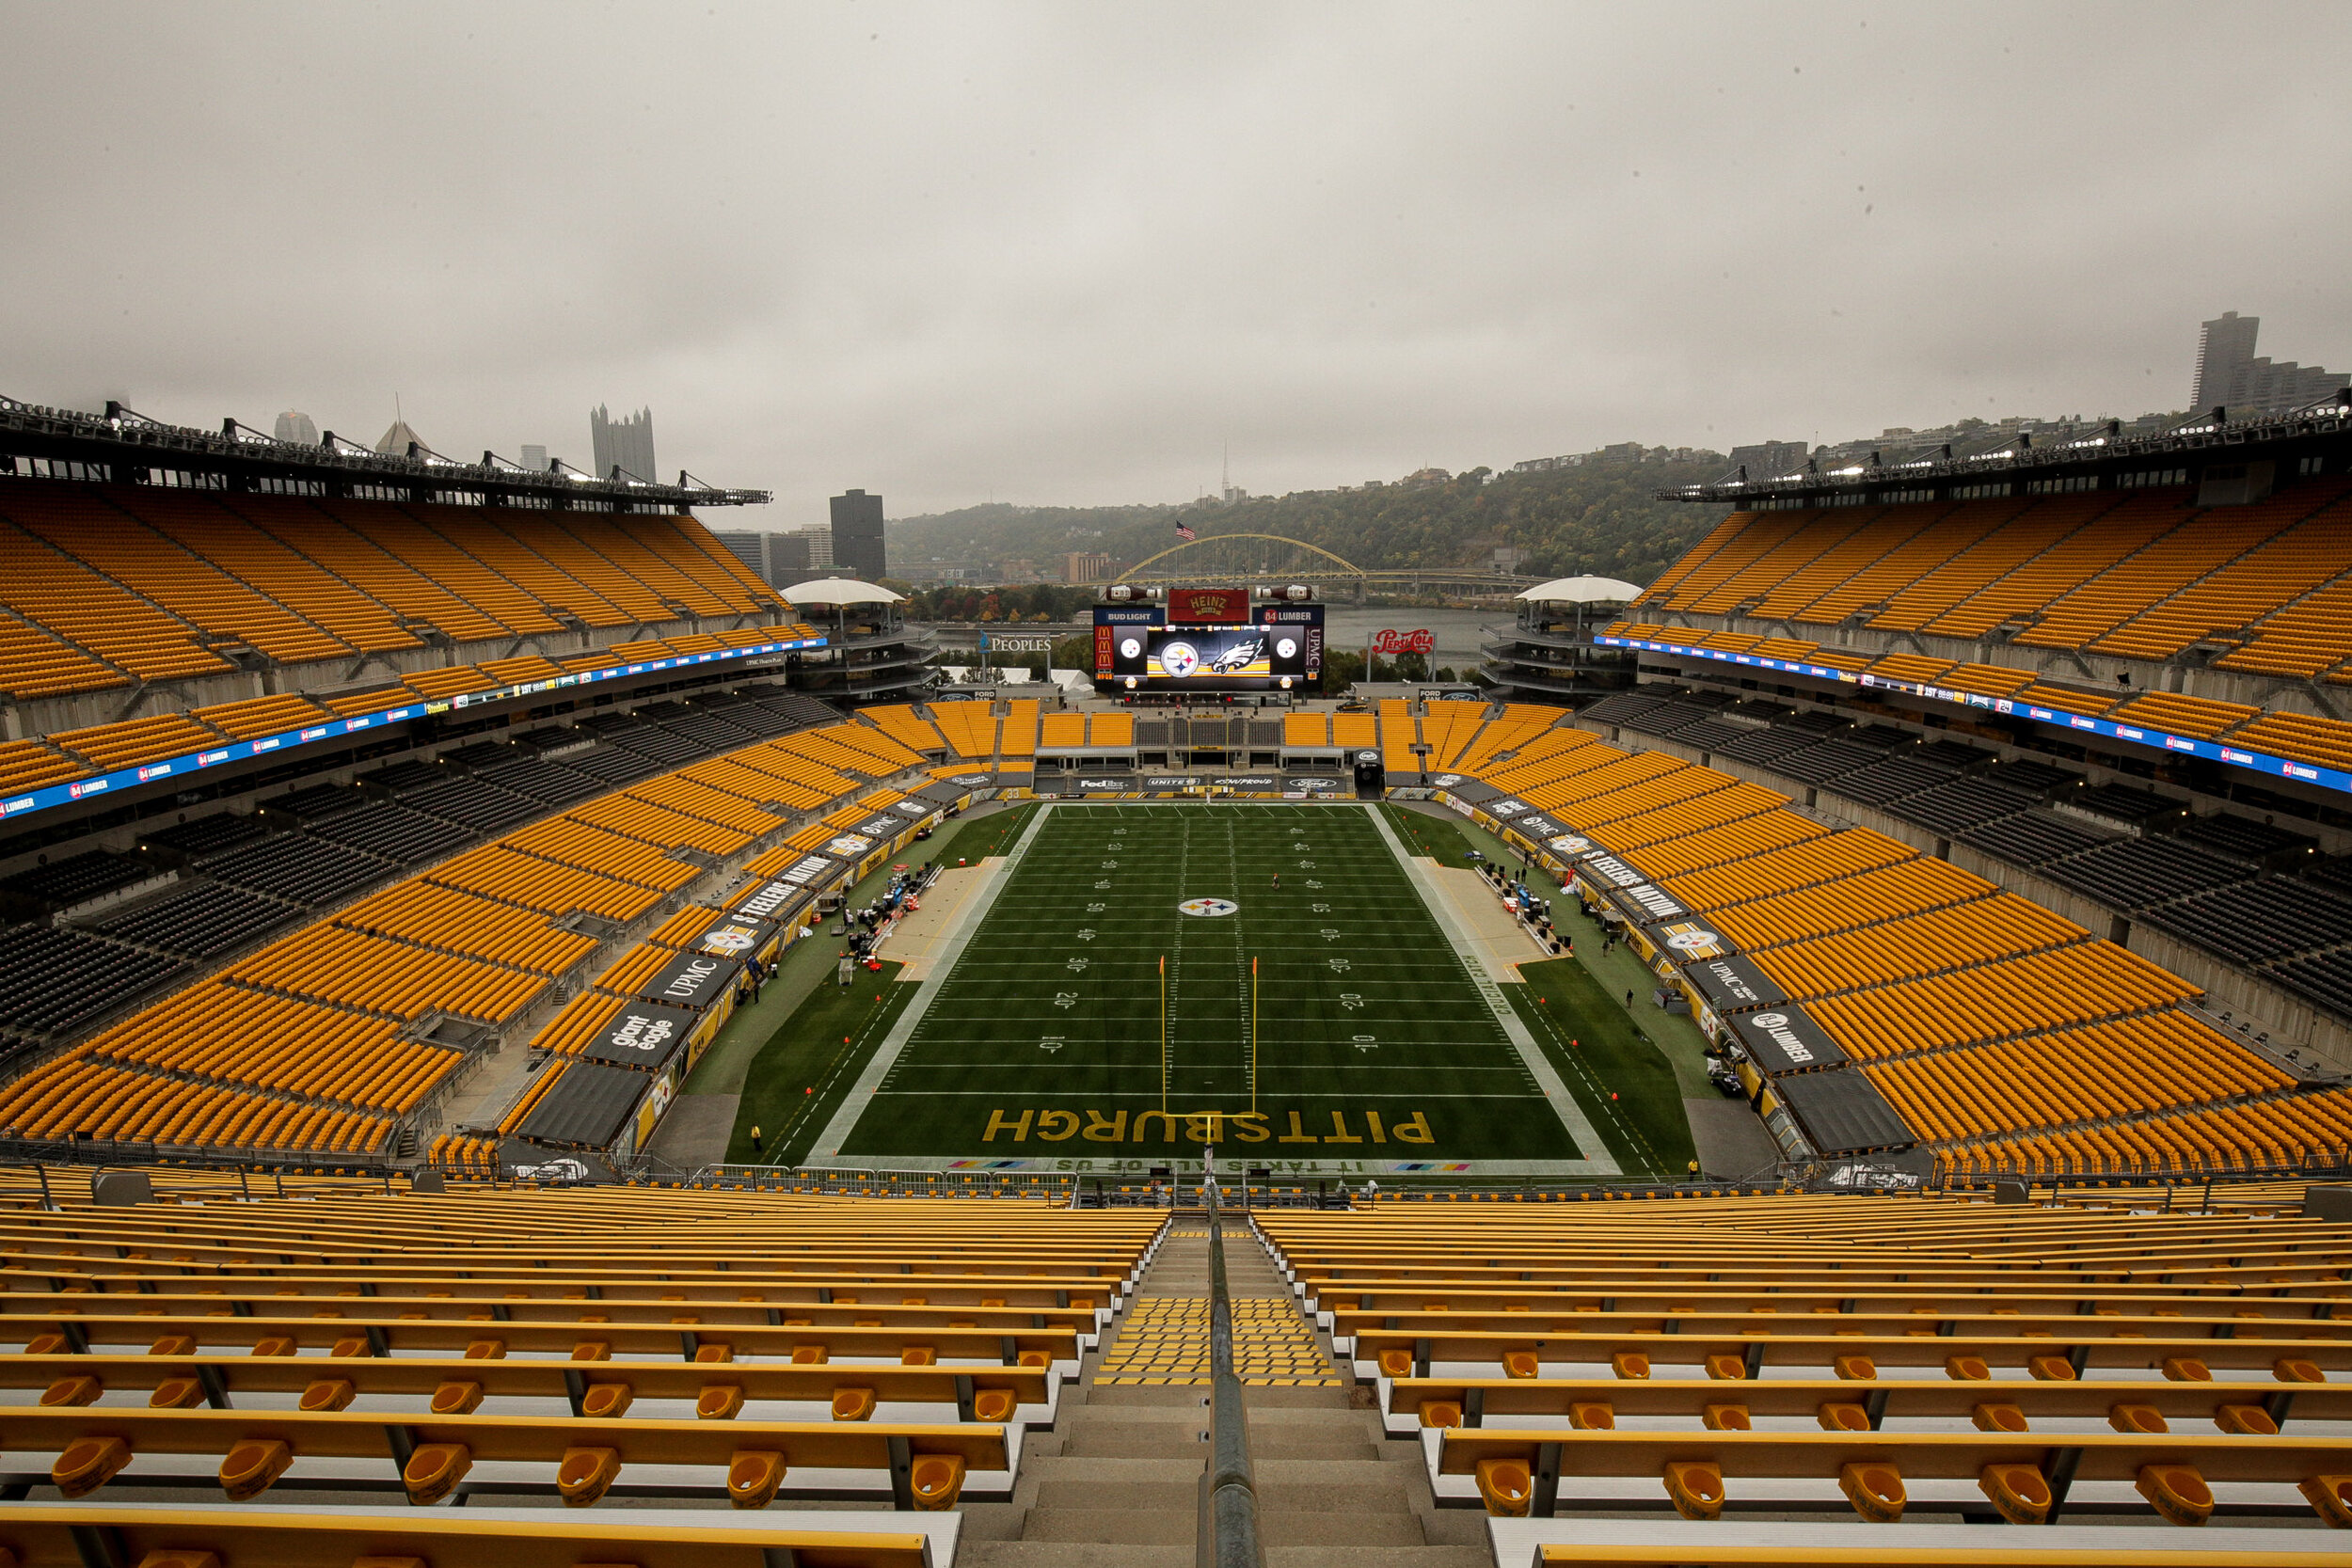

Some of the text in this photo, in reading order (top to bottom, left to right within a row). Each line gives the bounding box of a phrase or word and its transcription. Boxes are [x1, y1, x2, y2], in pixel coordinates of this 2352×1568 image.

[1190, 595, 1228, 609] HEINZ
[1265, 611, 1311, 621] 84 LUMBER
[992, 638, 1052, 651] PEOPLES
[1310, 628, 1321, 666] UPMC
[520, 685, 532, 694] 1ST
[1925, 687, 1937, 697] 1ST
[427, 703, 450, 715] Steelers
[207, 751, 229, 763] LUMBER
[2230, 752, 2254, 765] LUMBER
[149, 764, 172, 778] LUMBER
[2292, 766, 2318, 780] LUMBER
[71, 780, 108, 797] 84 LUMBER
[6, 797, 35, 814] LUMBER
[878, 816, 898, 830] PNC
[1532, 821, 1559, 835] PNC
[731, 881, 798, 925] STEELERS
[781, 855, 832, 884] NATION
[1581, 850, 1644, 887] STEELERS
[1627, 884, 1683, 917] NATION
[663, 959, 717, 997] UPMC
[1708, 961, 1742, 991] UPMC
[1461, 955, 1512, 1015] CRUCIAL CATCH
[1732, 988, 1746, 999] PLAN
[1740, 986, 1759, 1002] HEALTH
[612, 1015, 650, 1048] giant
[637, 1020, 674, 1051] eagle
[1768, 1026, 1814, 1063] LUMBER
[981, 1109, 1436, 1144] PITTSBURGH
[1056, 1159, 1093, 1172] US
[1108, 1160, 1143, 1171] OF
[1227, 1161, 1319, 1172] TAKES
[1339, 1161, 1363, 1172] IT
